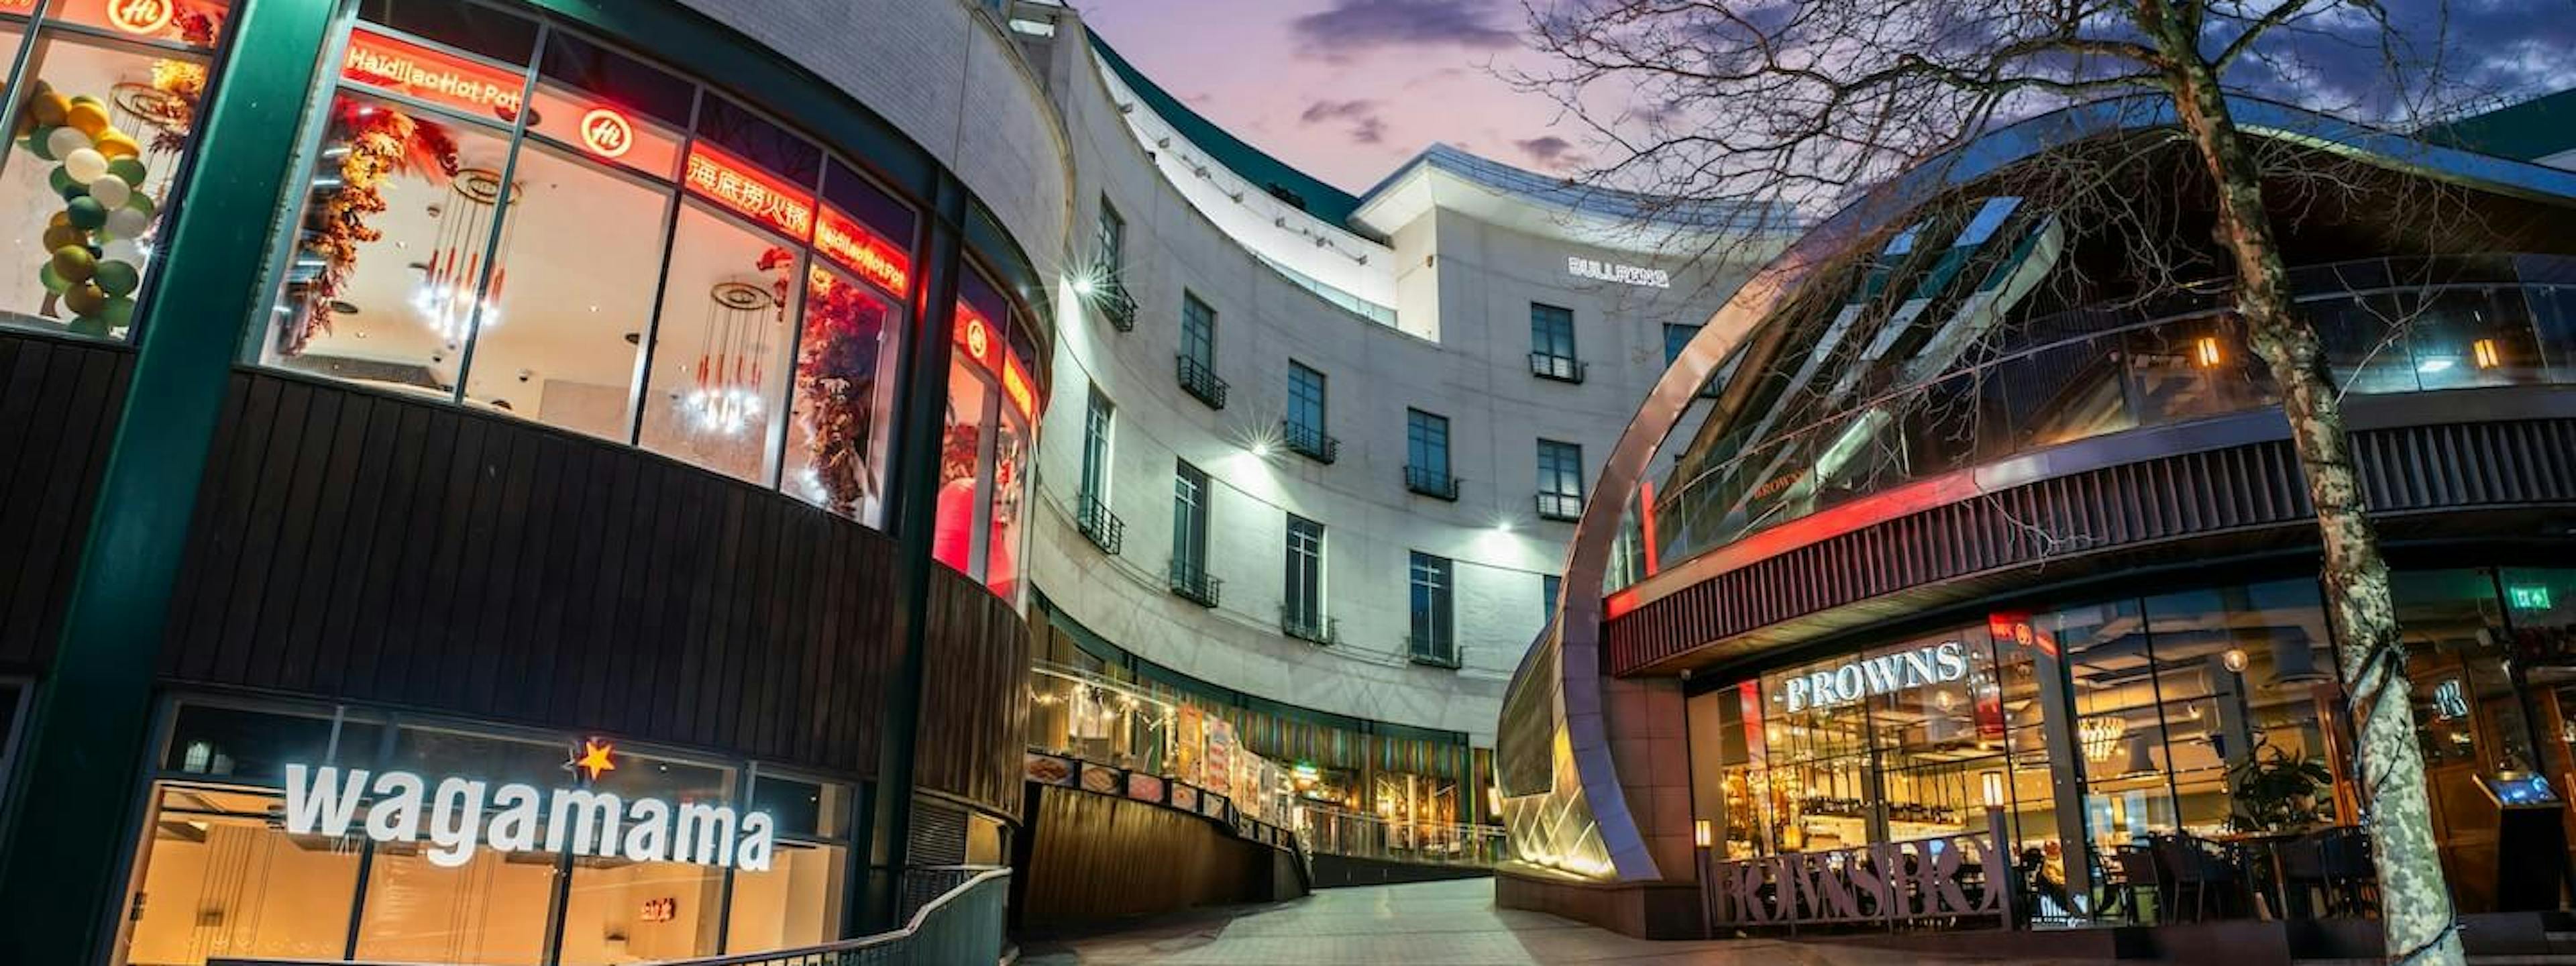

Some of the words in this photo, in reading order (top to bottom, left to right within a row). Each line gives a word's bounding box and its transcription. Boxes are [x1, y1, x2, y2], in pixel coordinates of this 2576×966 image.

[438, 73, 479, 100] Hot
[482, 84, 521, 112] Pot
[686, 154, 809, 231] 海底捞火锅
[1785, 641, 1970, 713] BROWNS
[285, 763, 773, 871] wagamama
